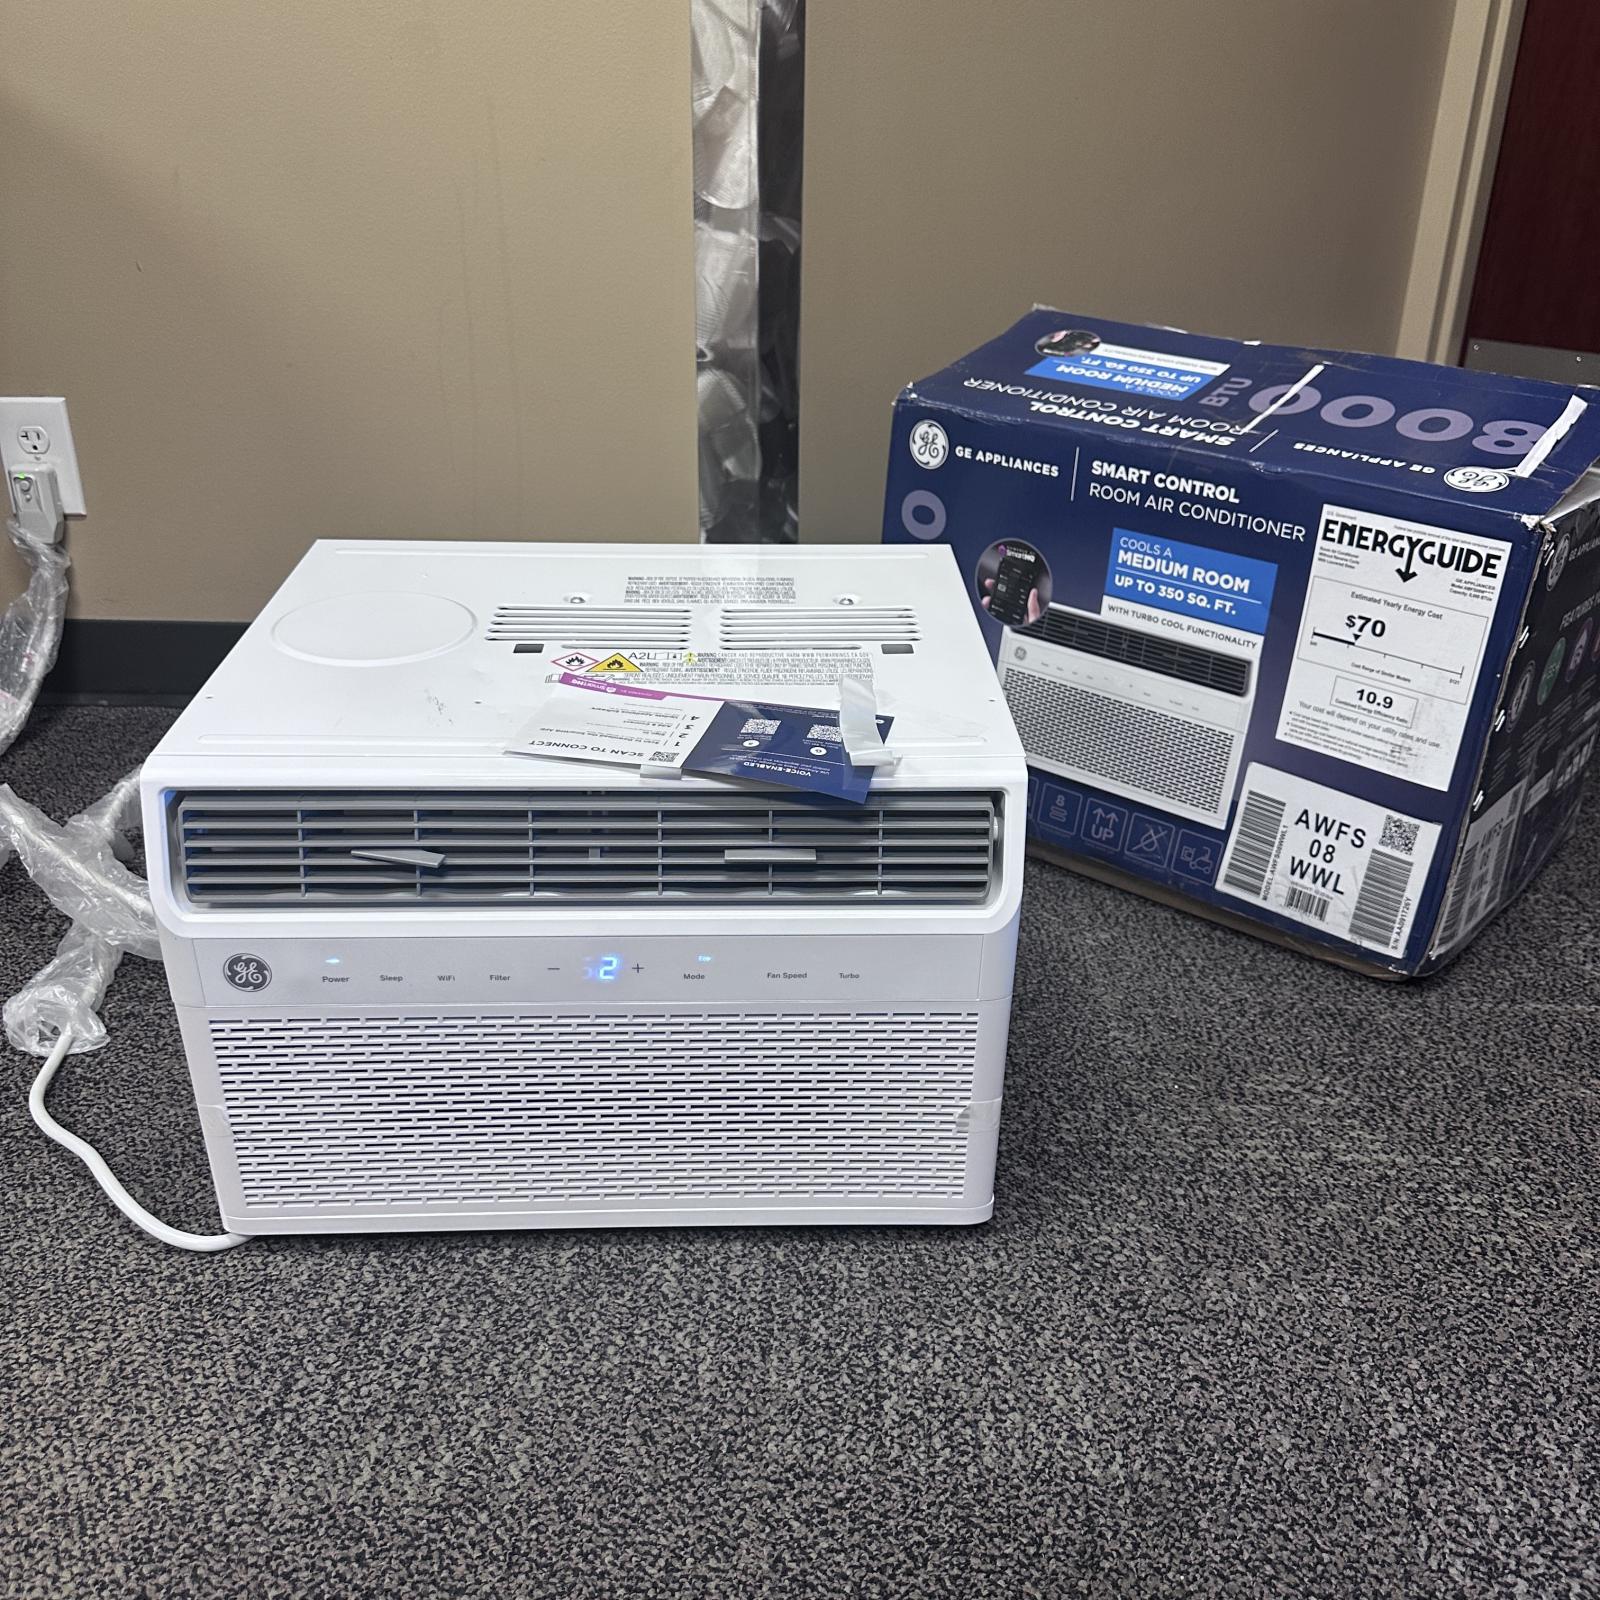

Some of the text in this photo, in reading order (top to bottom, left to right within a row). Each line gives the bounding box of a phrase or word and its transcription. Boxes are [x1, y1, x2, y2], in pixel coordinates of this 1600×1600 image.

[1056, 364, 1189, 393] MEDIUM ROOM
[1199, 377, 1252, 408] BTU
[964, 377, 1246, 436] ROOM AIR CONDITIONER
[1249, 384, 1549, 455] 8000
[1030, 401, 1236, 446] SMART CONTROL
[955, 445, 1060, 477] GE APPLIANCES
[1294, 442, 1436, 474] GE APPLIANCES
[1091, 460, 1241, 504] SMART CONTROL
[1089, 482, 1306, 542] ROOM AIR CONDITIONER
[1119, 536, 1173, 558] COOLS A
[1322, 518, 1502, 580] ENERGYGUIDE
[1117, 550, 1251, 594] MEDIUM ROOM
[1114, 573, 1236, 615] UP TO 350 SQ. FT.
[1350, 591, 1443, 621] Estimated Yearly Energy Cost
[1107, 604, 1258, 649] WITH TURBO COOL FUNCTIONALITY
[1345, 614, 1386, 638] $70
[628, 652, 653, 660] A2L
[1356, 688, 1393, 709] 10.9
[1336, 710, 1359, 724] depend
[1367, 721, 1381, 731] your
[528, 740, 588, 750] CONNECT
[611, 749, 645, 757] SCAN
[743, 761, 812, 777] VOICE-ENABLED
[1091, 824, 1114, 840] UP
[1294, 808, 1366, 849] AWFS
[1309, 839, 1336, 864] 08
[1290, 856, 1345, 895] WWL
[322, 975, 350, 984] Power
[379, 974, 403, 984] Sleep
[437, 974, 456, 982] WiFi
[489, 974, 511, 982] Filter
[683, 973, 705, 981] Mode
[782, 972, 808, 981] Speed
